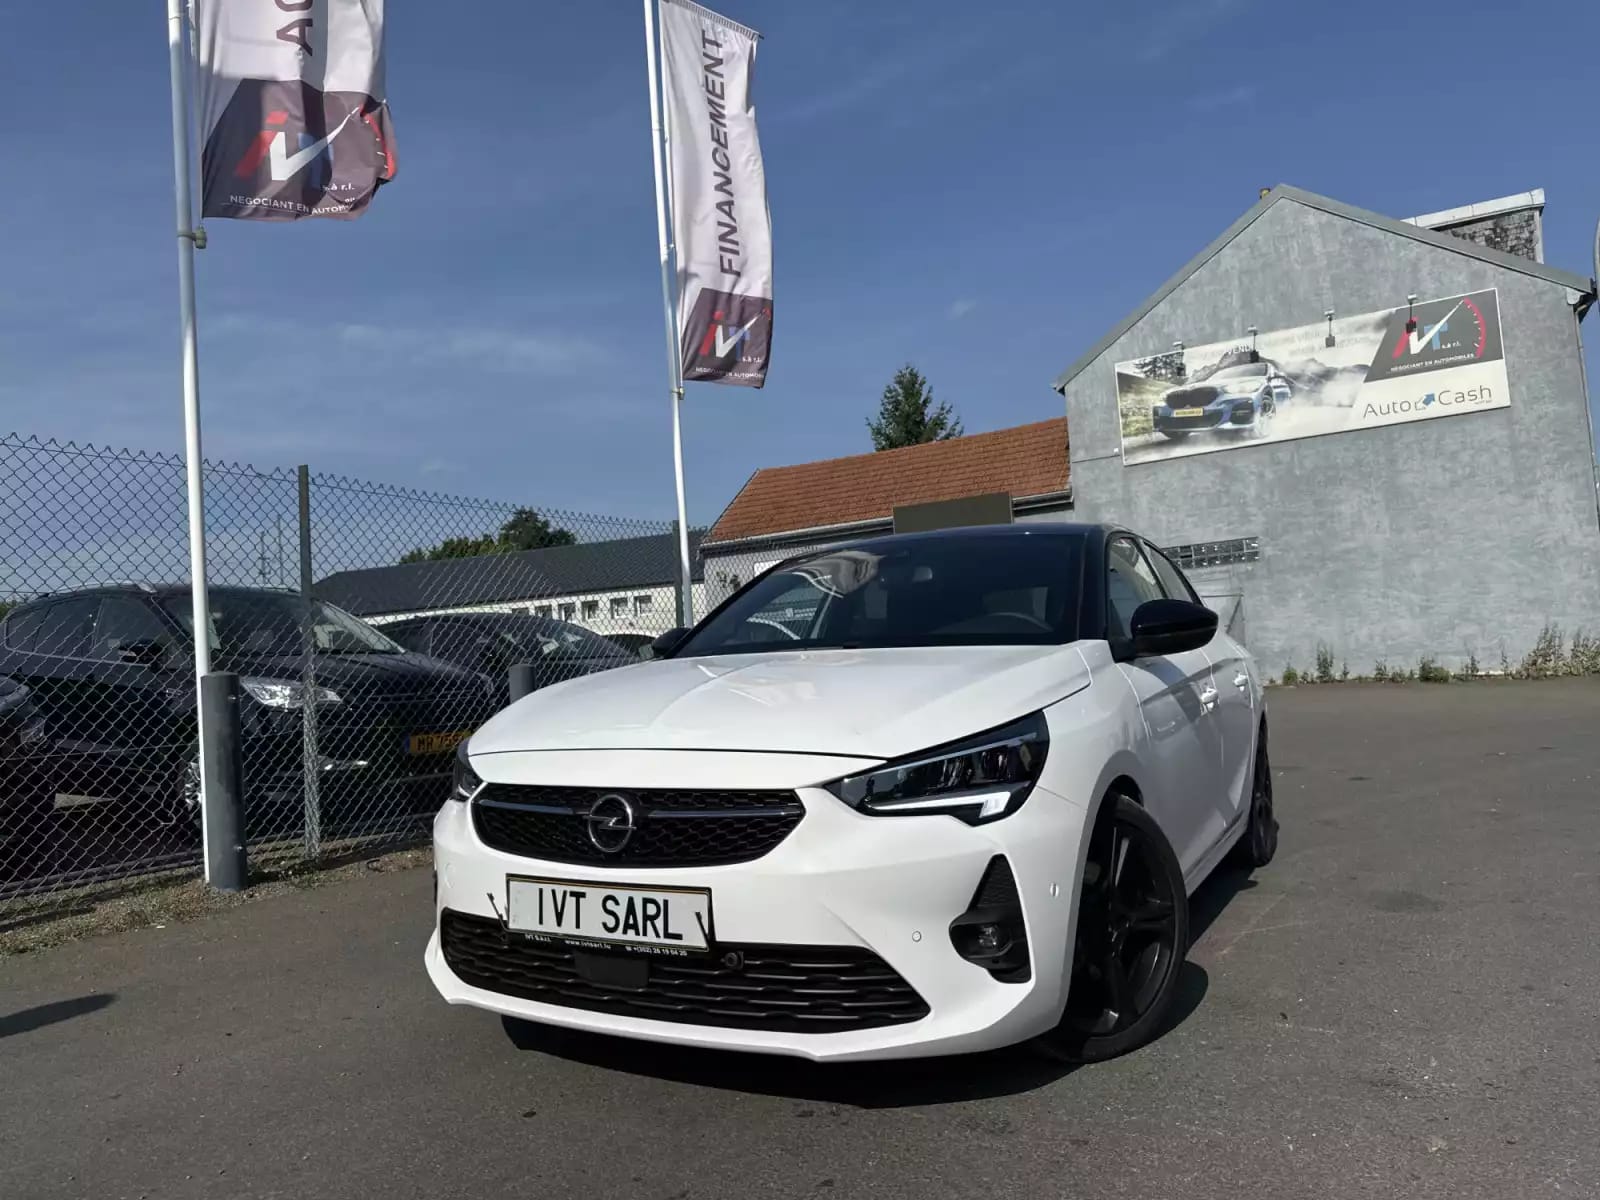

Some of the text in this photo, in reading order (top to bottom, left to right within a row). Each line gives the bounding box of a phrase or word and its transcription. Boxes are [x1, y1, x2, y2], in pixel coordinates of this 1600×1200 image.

[701, 29, 742, 278] FINANCEMENT
[230, 195, 294, 210] NEGOCIANT
[295, 202, 309, 213] EN
[1363, 385, 1492, 418] Auto Cash
[538, 887, 684, 941] IVT SARL
